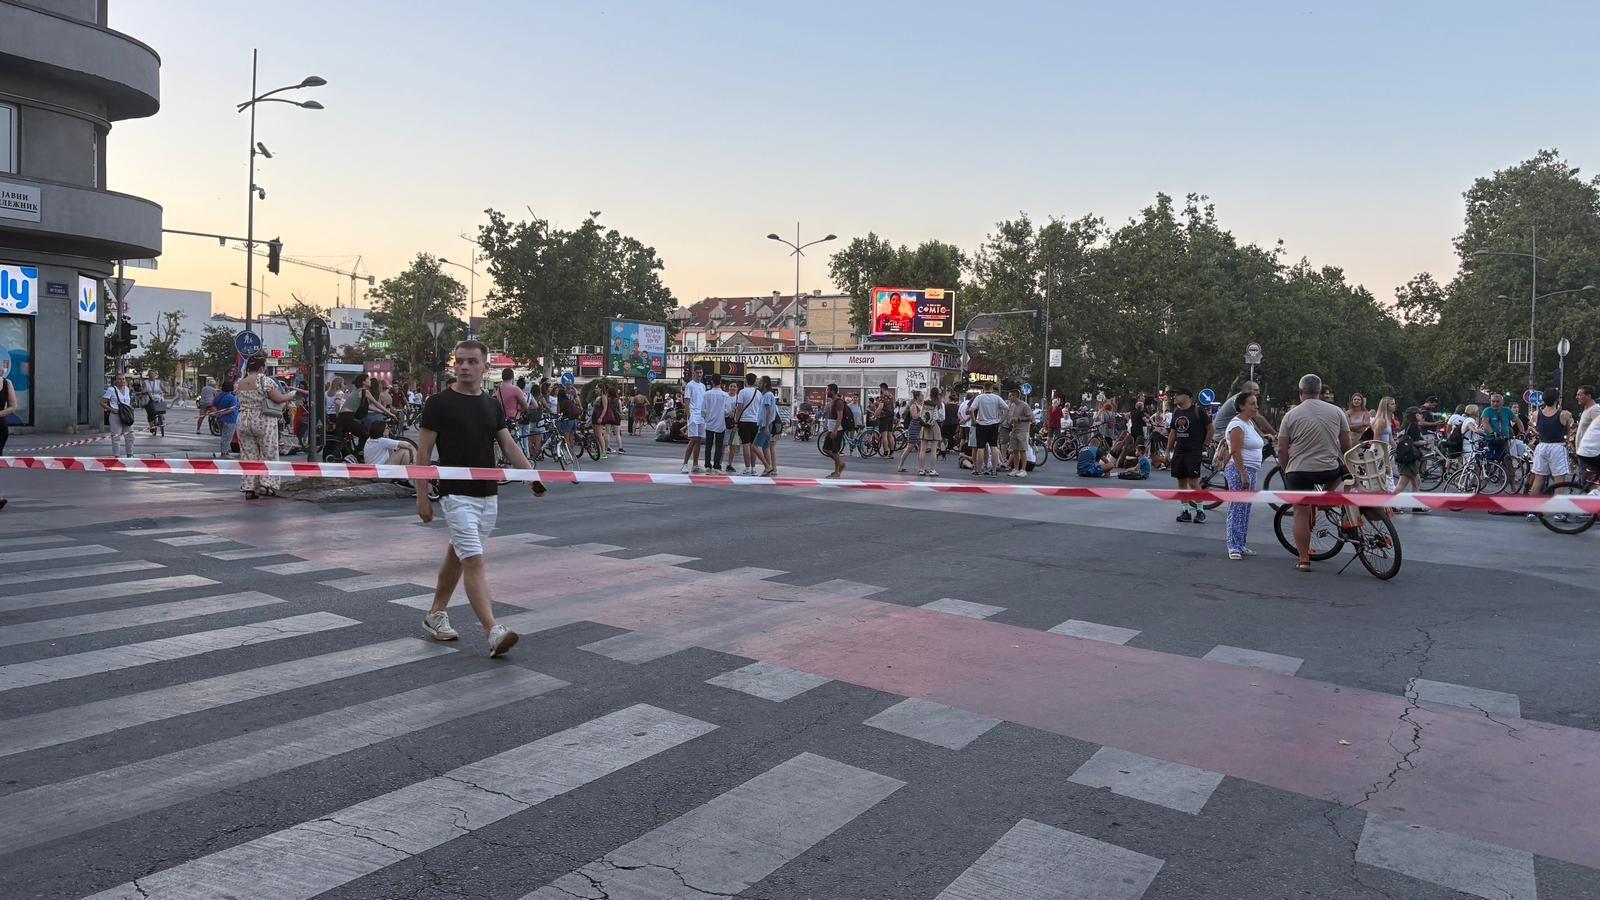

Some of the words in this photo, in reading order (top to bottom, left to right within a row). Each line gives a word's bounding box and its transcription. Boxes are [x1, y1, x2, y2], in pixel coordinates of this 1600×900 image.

[2, 191, 28, 200] ЈАВНИ
[848, 356, 875, 364] Mesara
[931, 352, 942, 367] BIG
